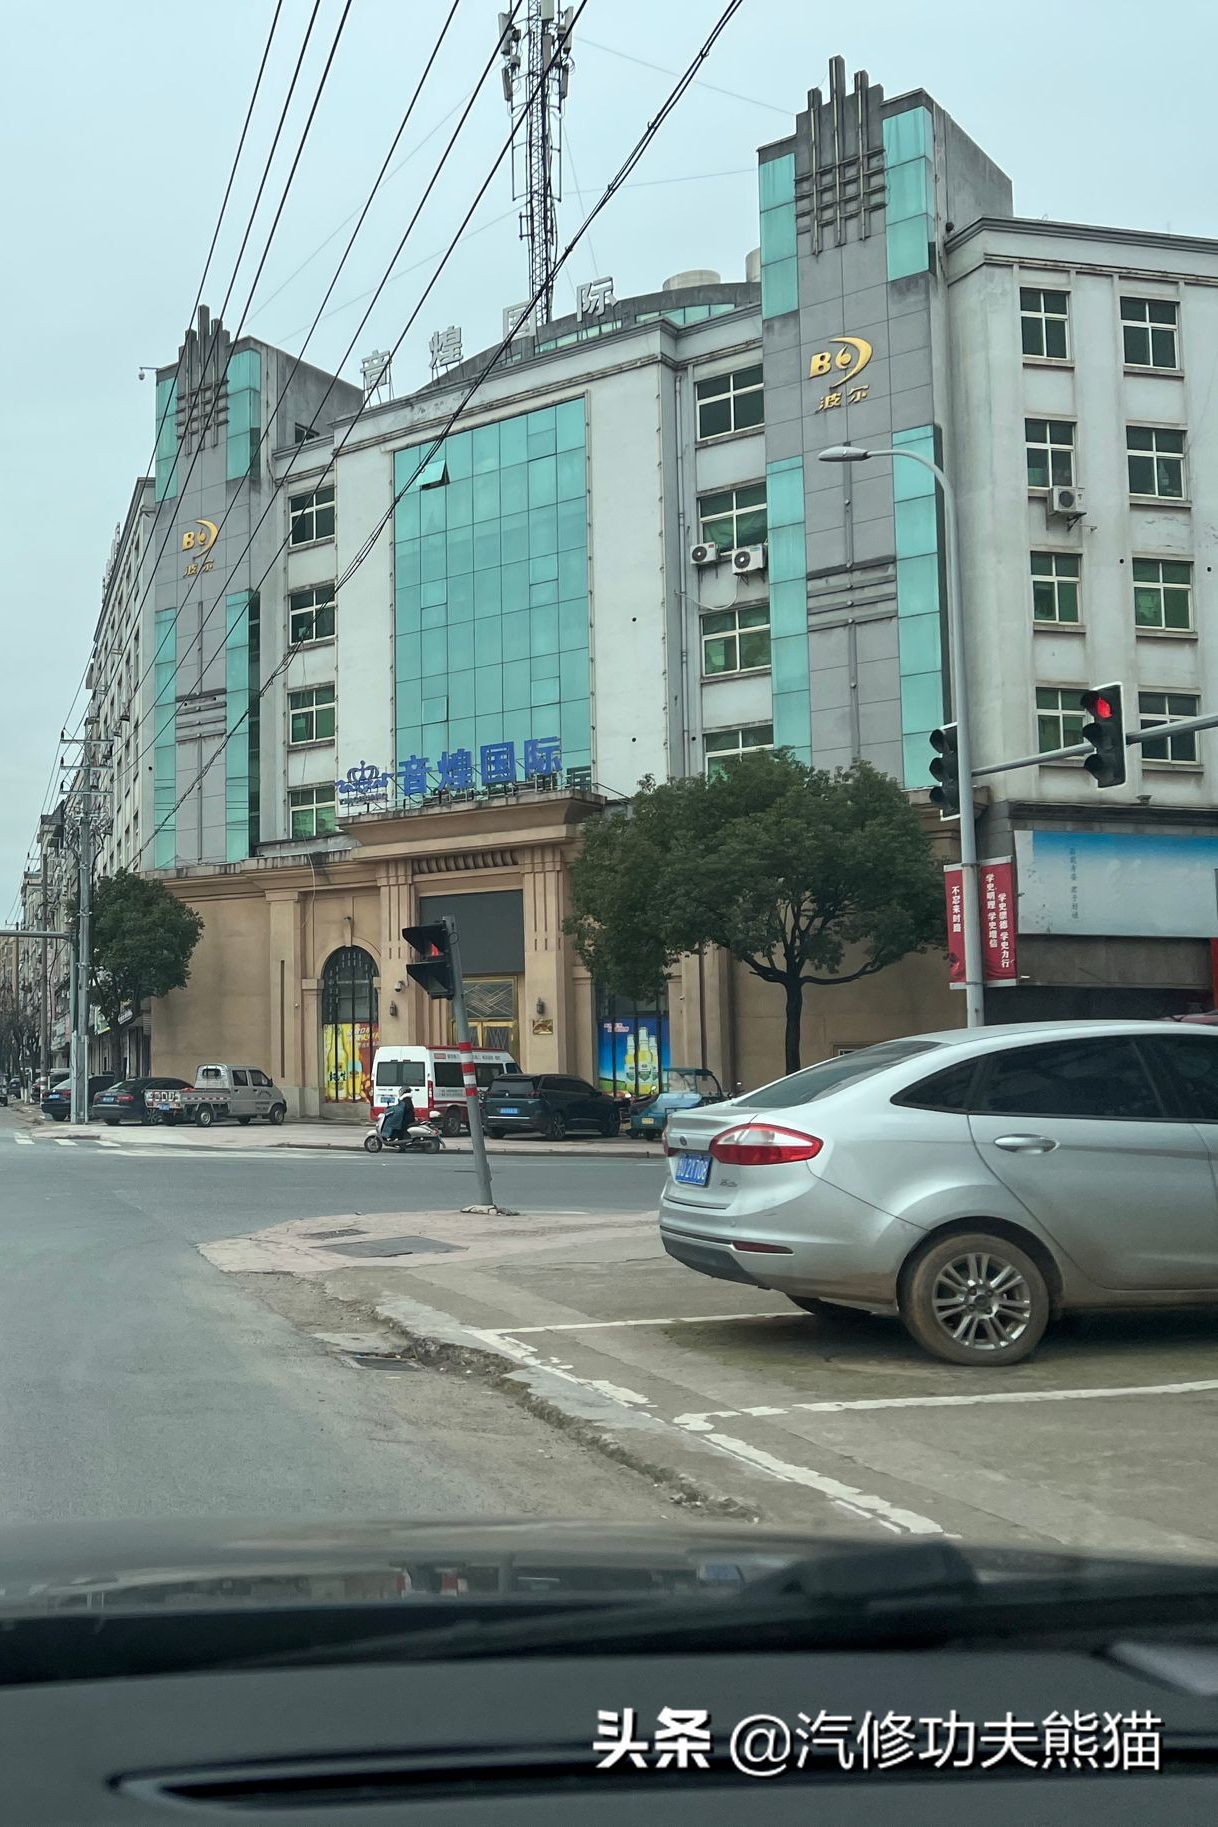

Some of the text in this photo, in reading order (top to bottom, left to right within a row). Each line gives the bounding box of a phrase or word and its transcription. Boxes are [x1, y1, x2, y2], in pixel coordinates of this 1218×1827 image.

[360, 276, 618, 389] 音煌国际
[398, 736, 562, 796] 音煌国际
